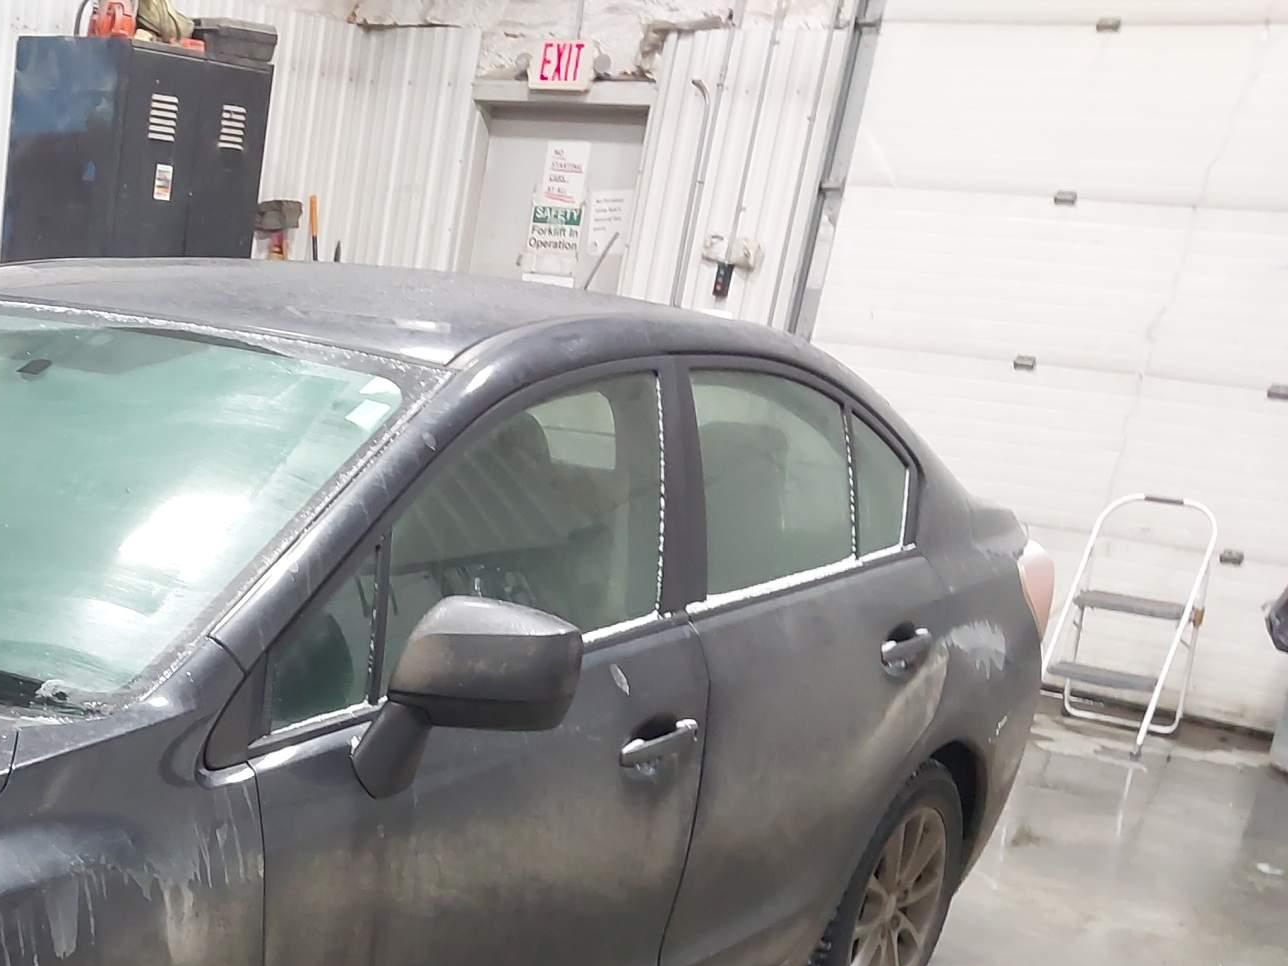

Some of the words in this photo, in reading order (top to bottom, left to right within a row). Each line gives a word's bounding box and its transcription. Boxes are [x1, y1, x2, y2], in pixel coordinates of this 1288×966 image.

[539, 43, 585, 81] EXIT
[535, 207, 580, 222] SAFETY
[532, 225, 567, 237] Forklift
[528, 237, 577, 250] Operation
